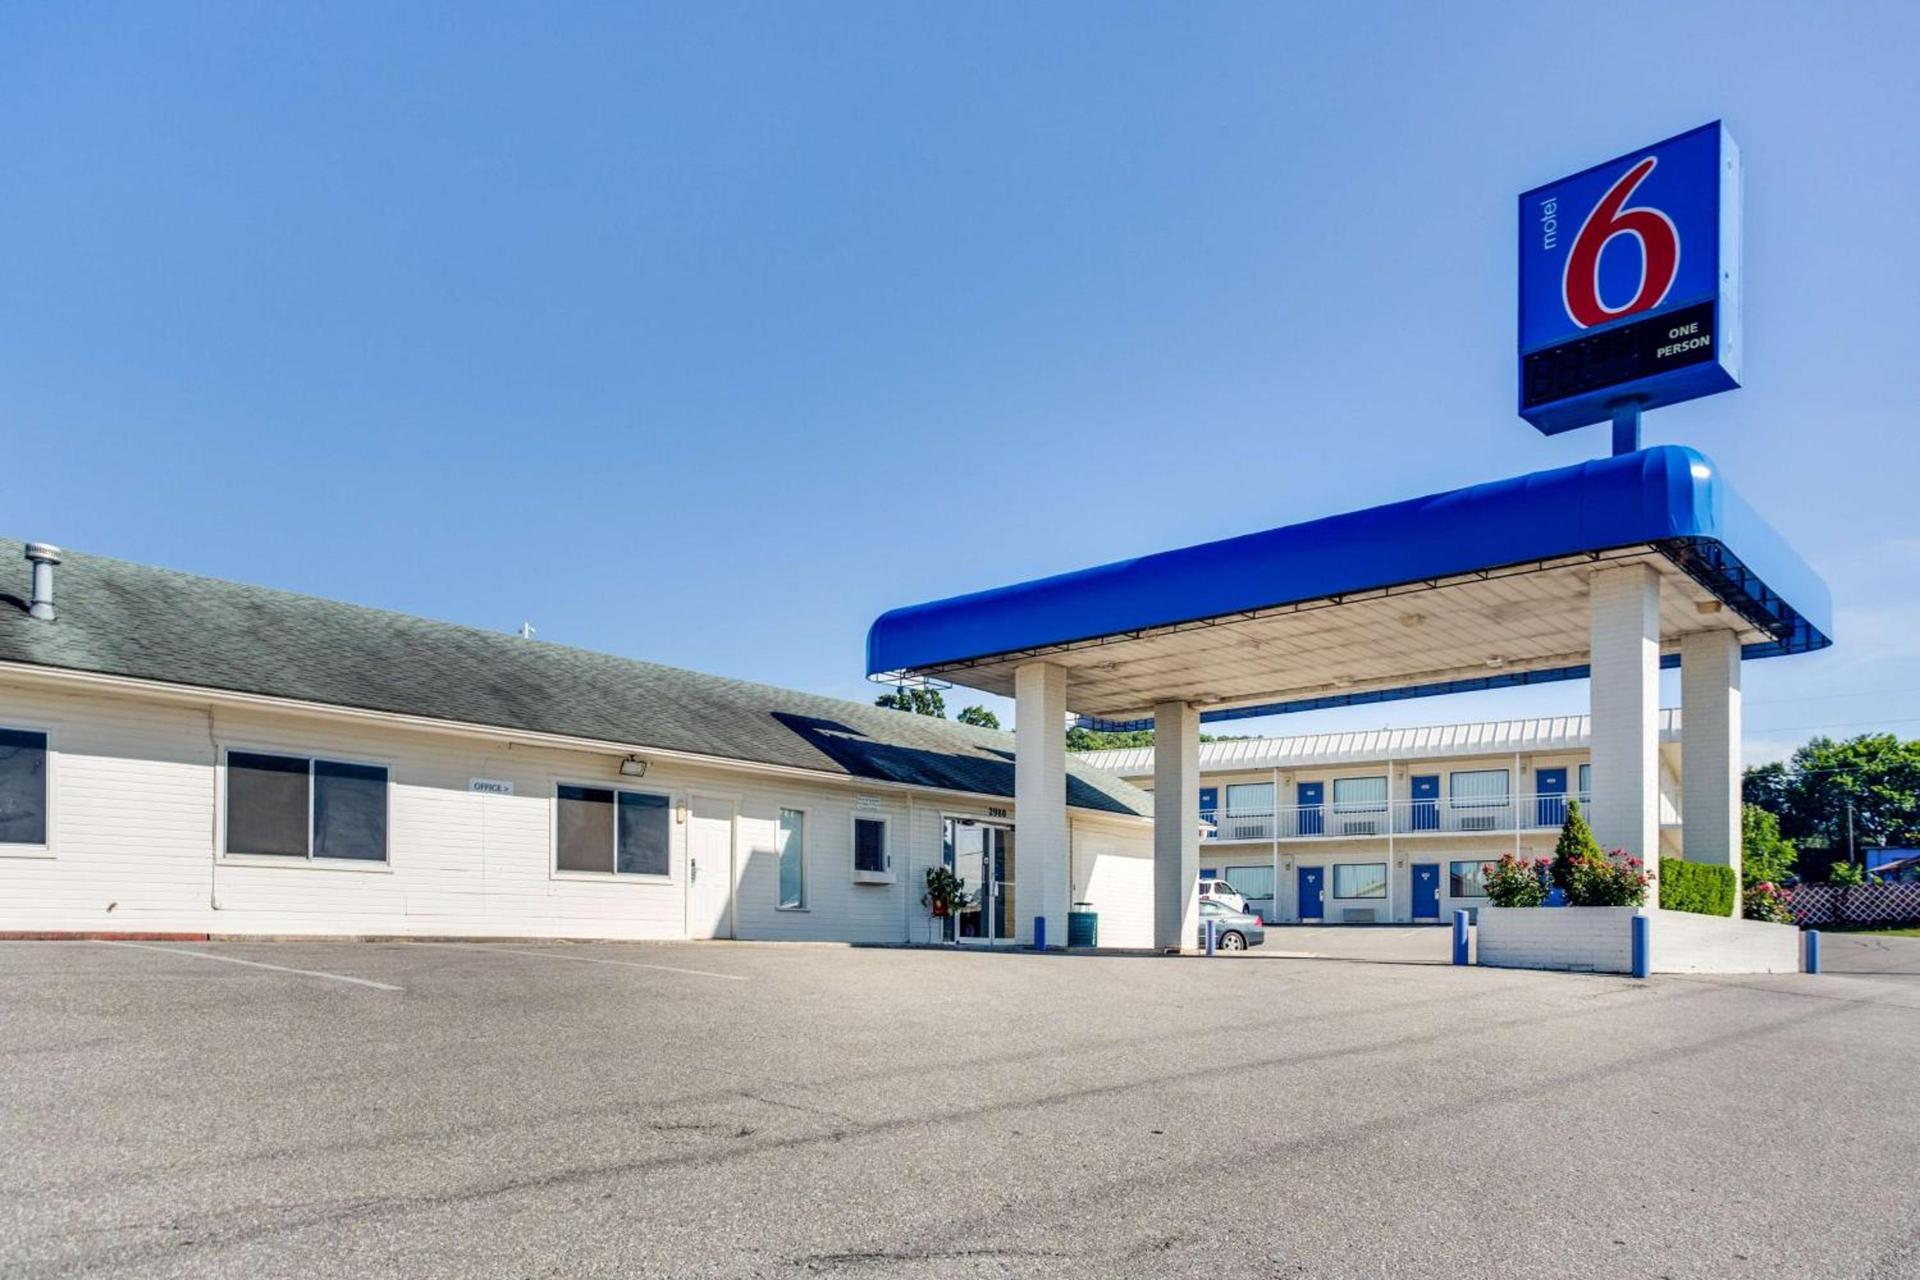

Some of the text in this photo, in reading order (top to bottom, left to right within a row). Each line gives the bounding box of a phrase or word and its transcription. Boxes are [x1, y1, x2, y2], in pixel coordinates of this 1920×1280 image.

[1540, 198, 1557, 250] motel
[1562, 156, 1680, 329] 6
[1669, 322, 1699, 339] ONE
[1657, 334, 1711, 358] PERSON
[473, 782, 502, 792] OFFICE
